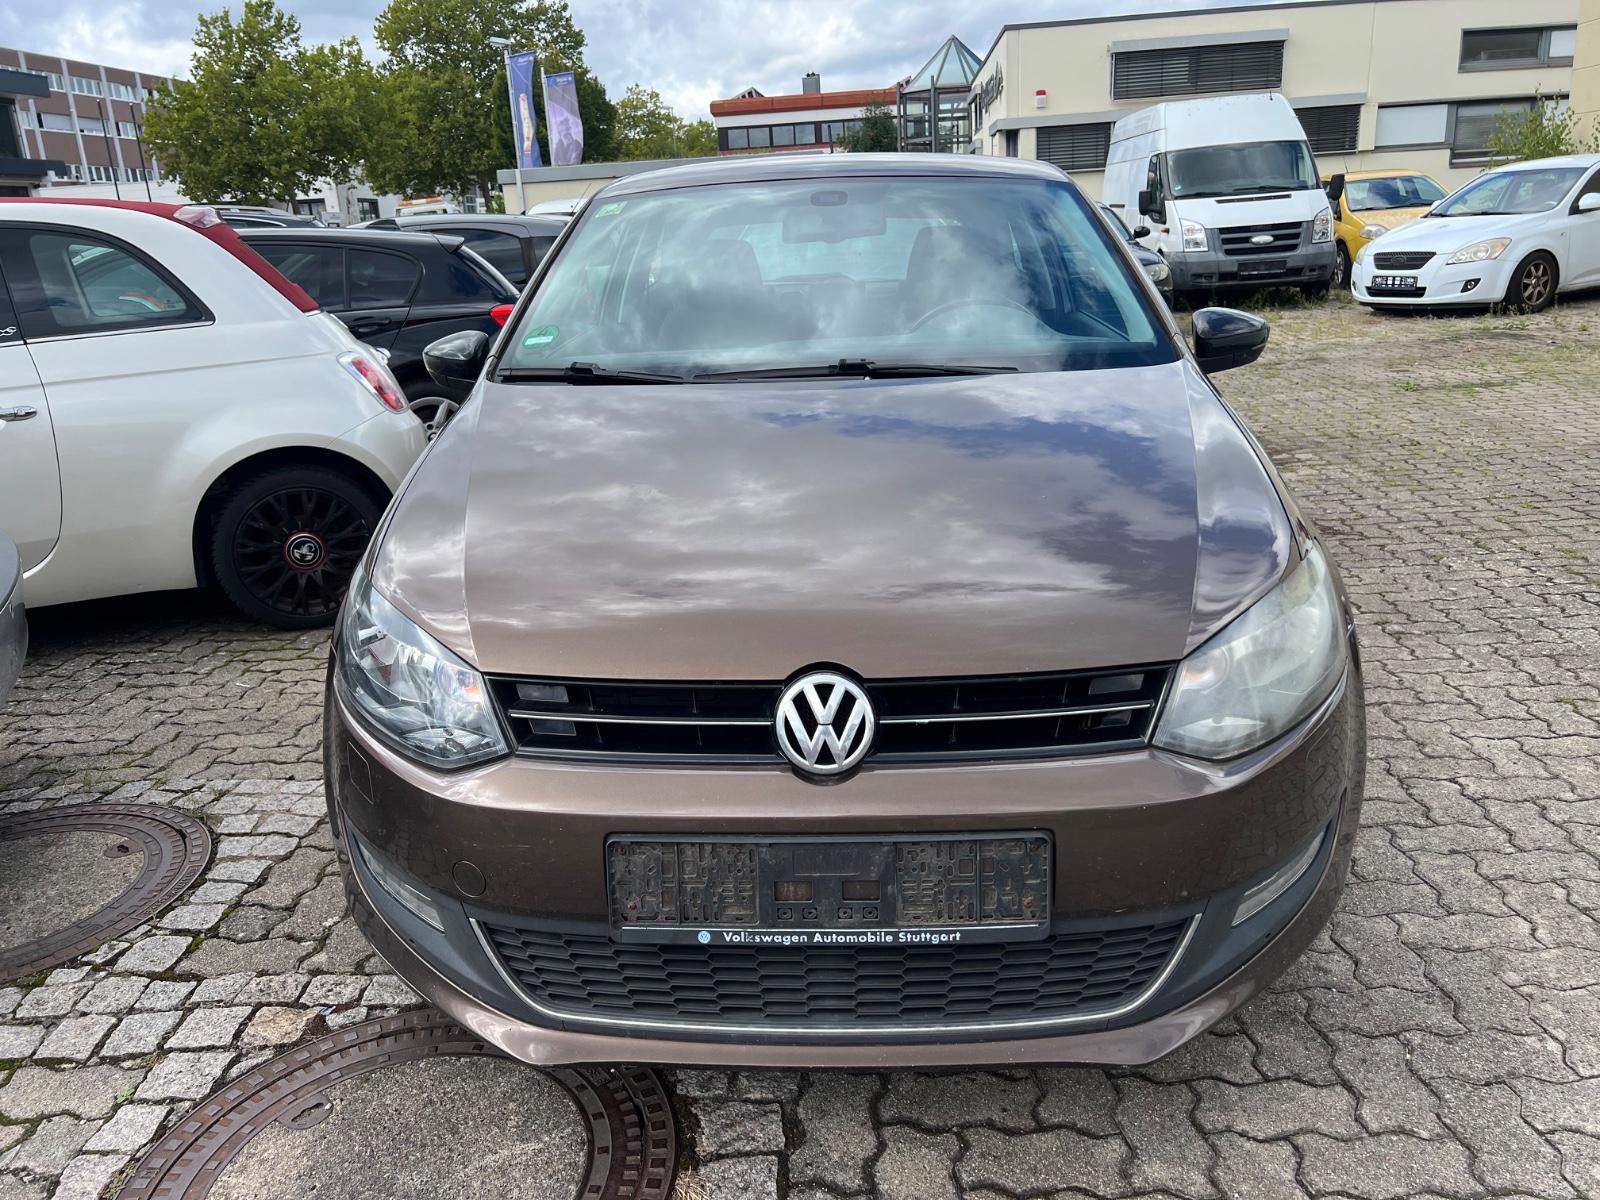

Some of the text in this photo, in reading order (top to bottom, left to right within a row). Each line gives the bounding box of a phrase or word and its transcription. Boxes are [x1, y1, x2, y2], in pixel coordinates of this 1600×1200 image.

[722, 931, 808, 946] Volkswagen
[813, 931, 894, 943] Automobile
[898, 931, 961, 944] Stuttgart
